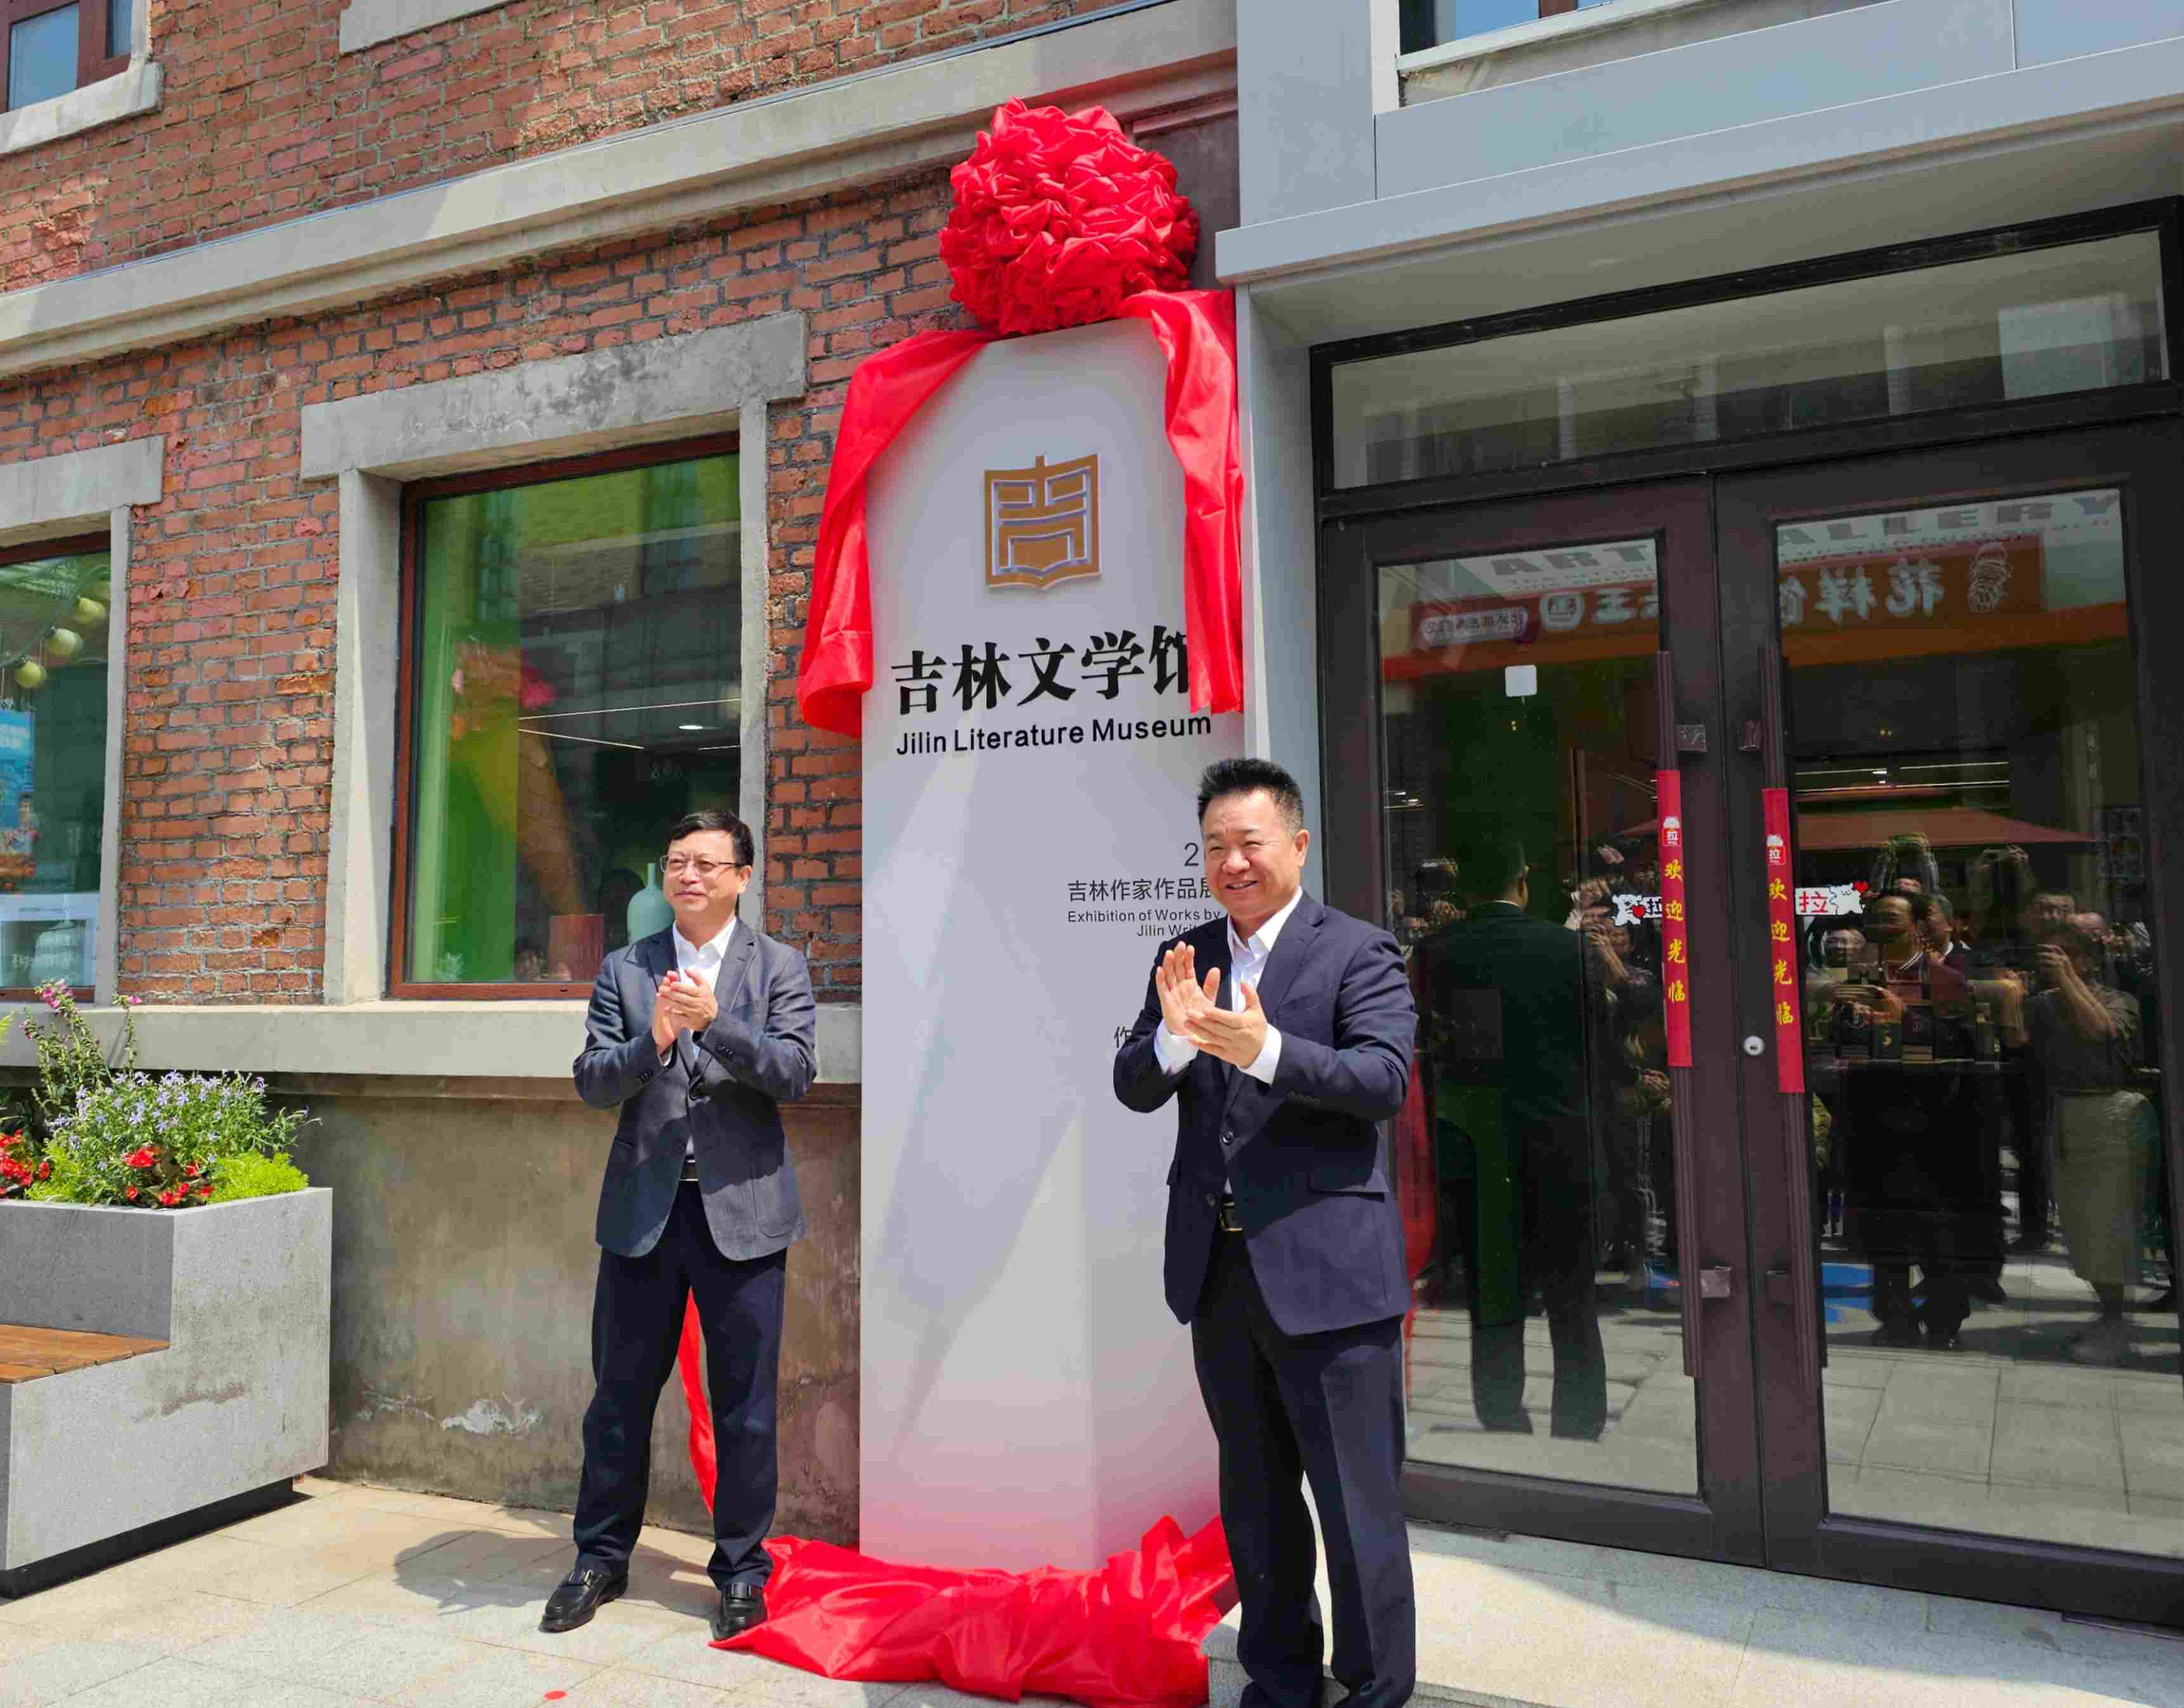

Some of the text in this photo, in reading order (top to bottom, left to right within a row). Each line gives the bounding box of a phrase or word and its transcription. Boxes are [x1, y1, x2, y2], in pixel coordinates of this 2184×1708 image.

[897, 717, 1212, 755] Jilin Literature Museum
[1068, 908, 1221, 922] Exhibition of Works by
[1798, 890, 1829, 913] 拉
[1137, 924, 1165, 937] Jilin
[1664, 858, 1685, 1004] 欢迎光临
[1769, 878, 1795, 1025] 欢迎光临
